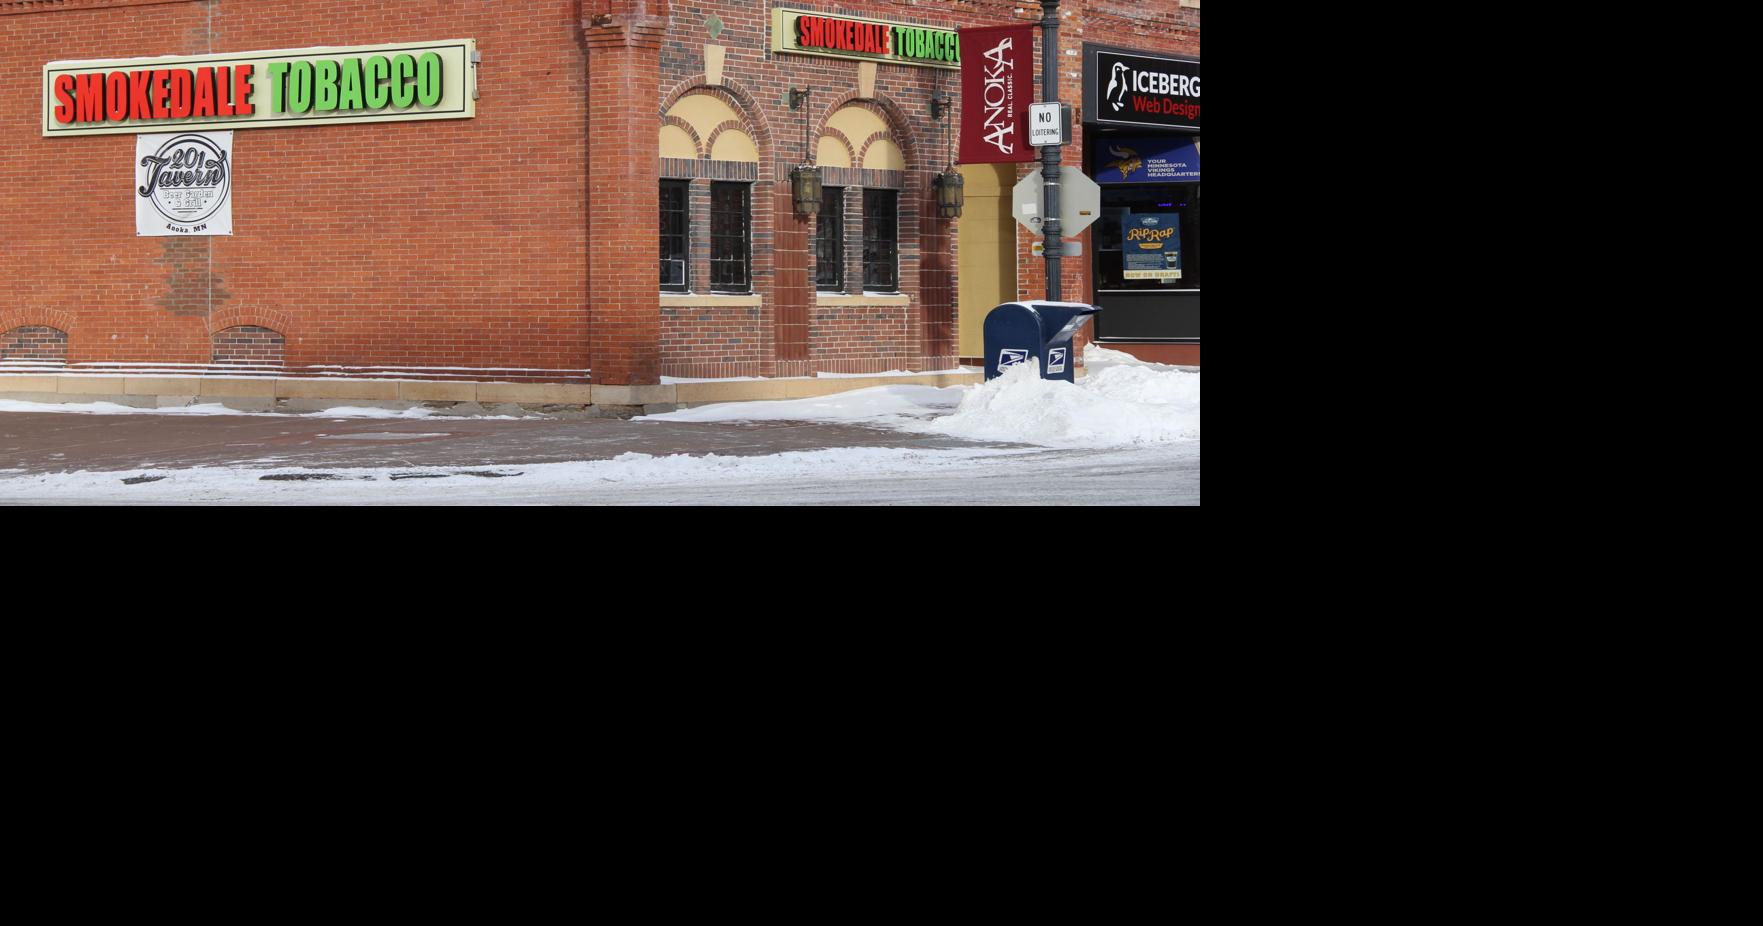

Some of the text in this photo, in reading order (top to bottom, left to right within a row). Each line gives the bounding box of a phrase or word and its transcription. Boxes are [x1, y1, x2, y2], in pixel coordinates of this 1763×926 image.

[797, 15, 890, 55] SMOKEDALE
[54, 52, 443, 124] SMOKEDALE TOBACCO
[983, 37, 1014, 154] ANOKA
[1132, 70, 1200, 97] ICEBERG
[1038, 112, 1052, 123] NO
[1132, 95, 1200, 120] Web Design
[1032, 128, 1059, 137] LOITERING
[169, 147, 206, 170] 201
[138, 150, 227, 197] Tavern
[163, 188, 214, 199] Beer Garden
[184, 198, 202, 208] Grill
[193, 223, 208, 233] MN
